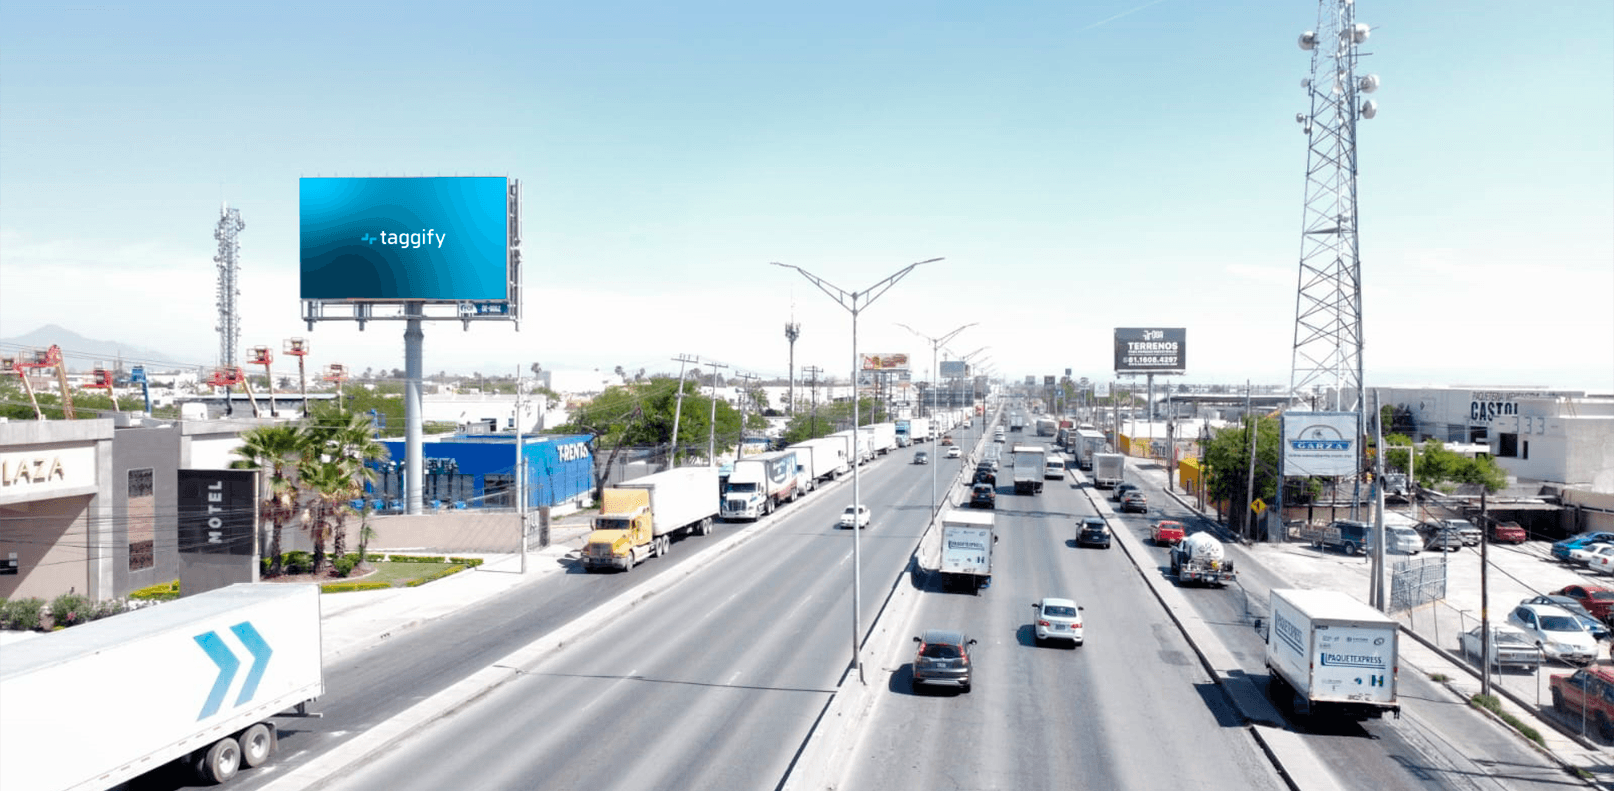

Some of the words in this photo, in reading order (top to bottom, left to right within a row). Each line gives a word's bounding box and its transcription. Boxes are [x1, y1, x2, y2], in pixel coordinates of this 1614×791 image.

[380, 229, 446, 248] taggify
[1128, 342, 1178, 350] TERRENOS
[1297, 442, 1343, 450] GARZA
[2, 458, 66, 487] LAZA
[208, 480, 222, 543] MOTEL
[1328, 654, 1382, 663] PAQUETEXPRESS
